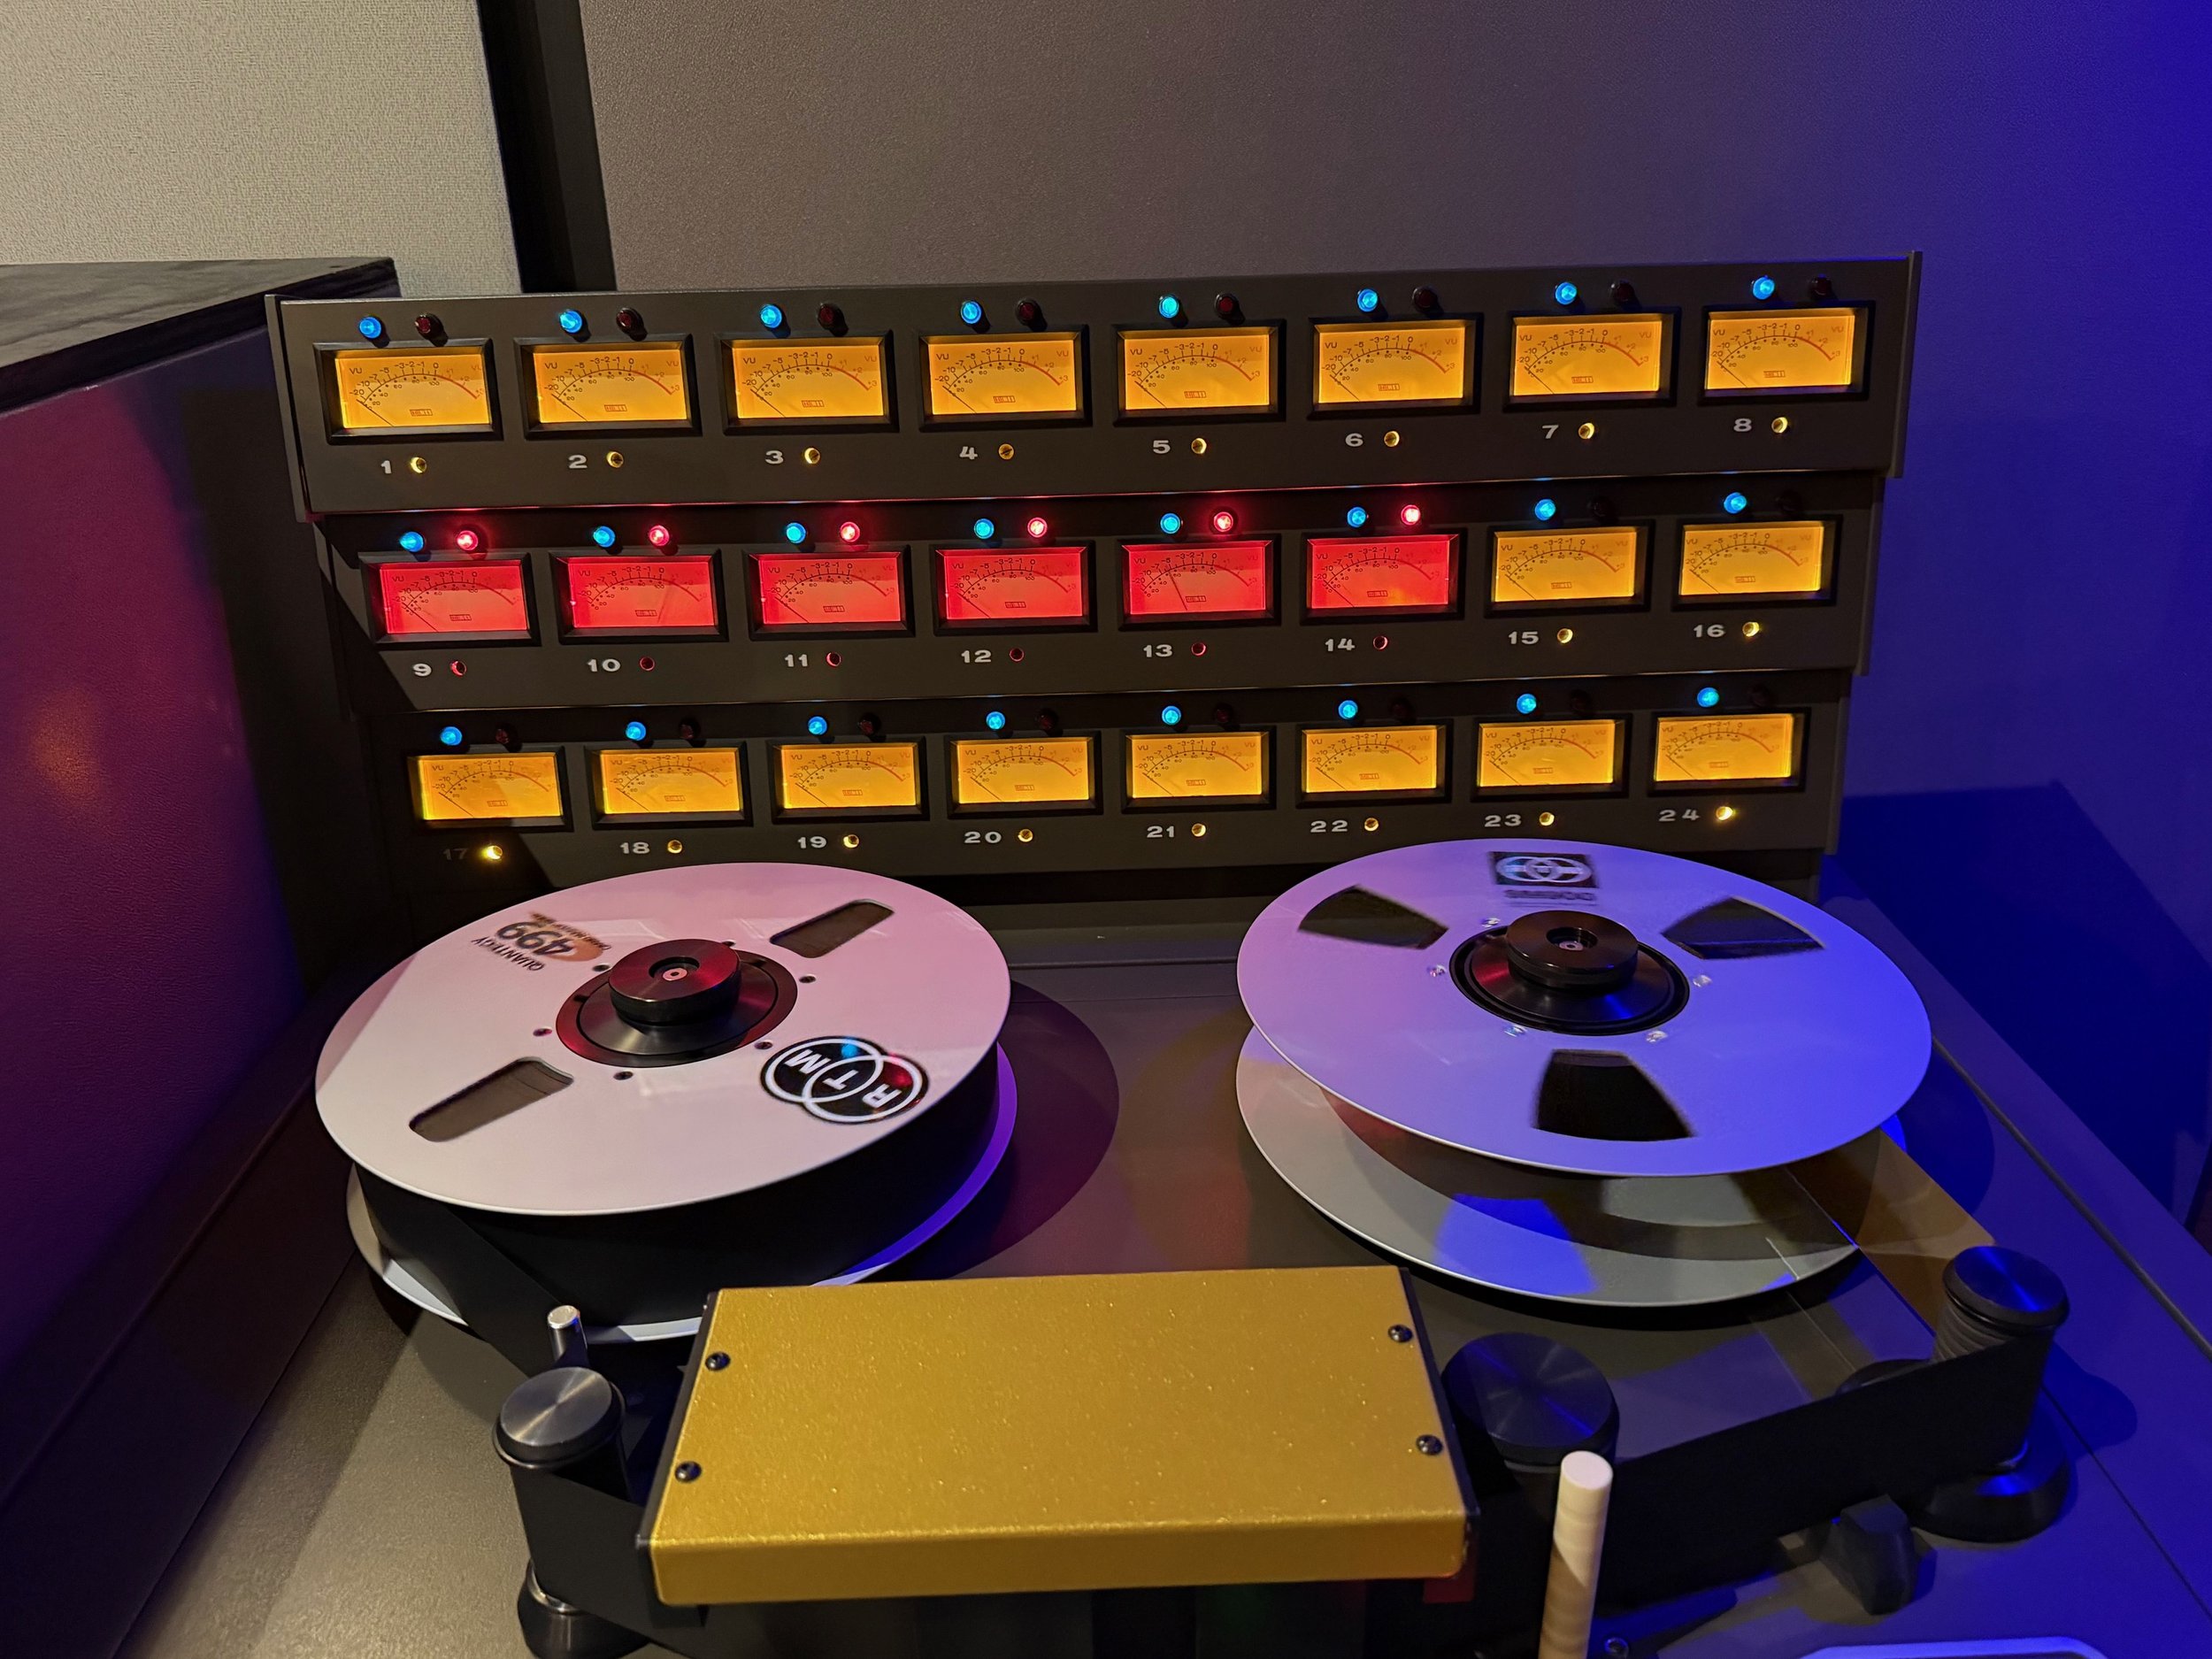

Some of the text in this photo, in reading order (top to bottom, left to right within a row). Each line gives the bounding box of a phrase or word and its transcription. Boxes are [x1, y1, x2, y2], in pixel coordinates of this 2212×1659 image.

[1733, 418, 1752, 432] 8
[1541, 425, 1559, 439] 7
[1345, 433, 1363, 447] 6
[959, 446, 978, 460] 4
[1153, 440, 1171, 454] 5
[568, 455, 588, 469] 2
[765, 450, 784, 465] 3
[380, 460, 392, 474] 1
[1509, 631, 1539, 644] 15
[1694, 625, 1725, 638] 16
[1143, 644, 1172, 657] 13
[1325, 639, 1356, 652] 14
[785, 654, 808, 667] 11
[961, 649, 992, 663] 12
[412, 664, 432, 676] 9
[588, 658, 621, 672] 10
[1485, 814, 1522, 827] 23
[1659, 810, 1700, 821] 24
[1147, 826, 1175, 838] 21
[1310, 820, 1348, 833] 22
[798, 836, 827, 849] 19
[964, 832, 1002, 843] 20
[442, 849, 468, 860] 17
[620, 842, 650, 854] 18
[495, 922, 575, 956] 499
[784, 1048, 902, 1109] RTM
